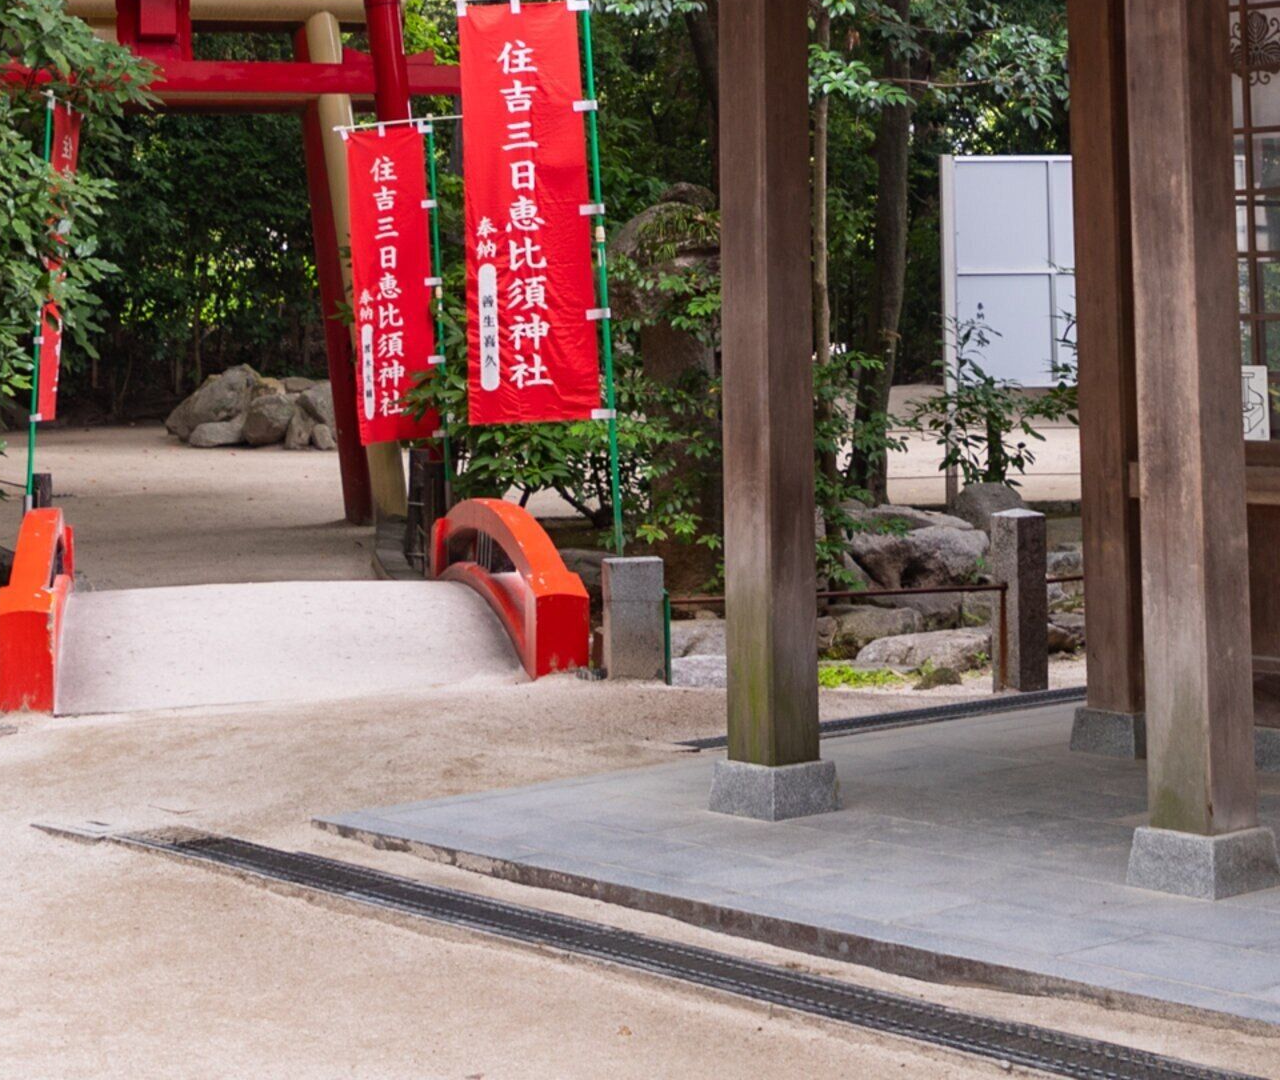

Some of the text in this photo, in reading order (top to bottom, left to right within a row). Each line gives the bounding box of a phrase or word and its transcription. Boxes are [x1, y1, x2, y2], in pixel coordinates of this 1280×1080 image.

[370, 155, 405, 417] 住吉三日恵比須神社
[476, 216, 497, 260] 奉納
[497, 39, 553, 390] 住吉三日恵比須神社
